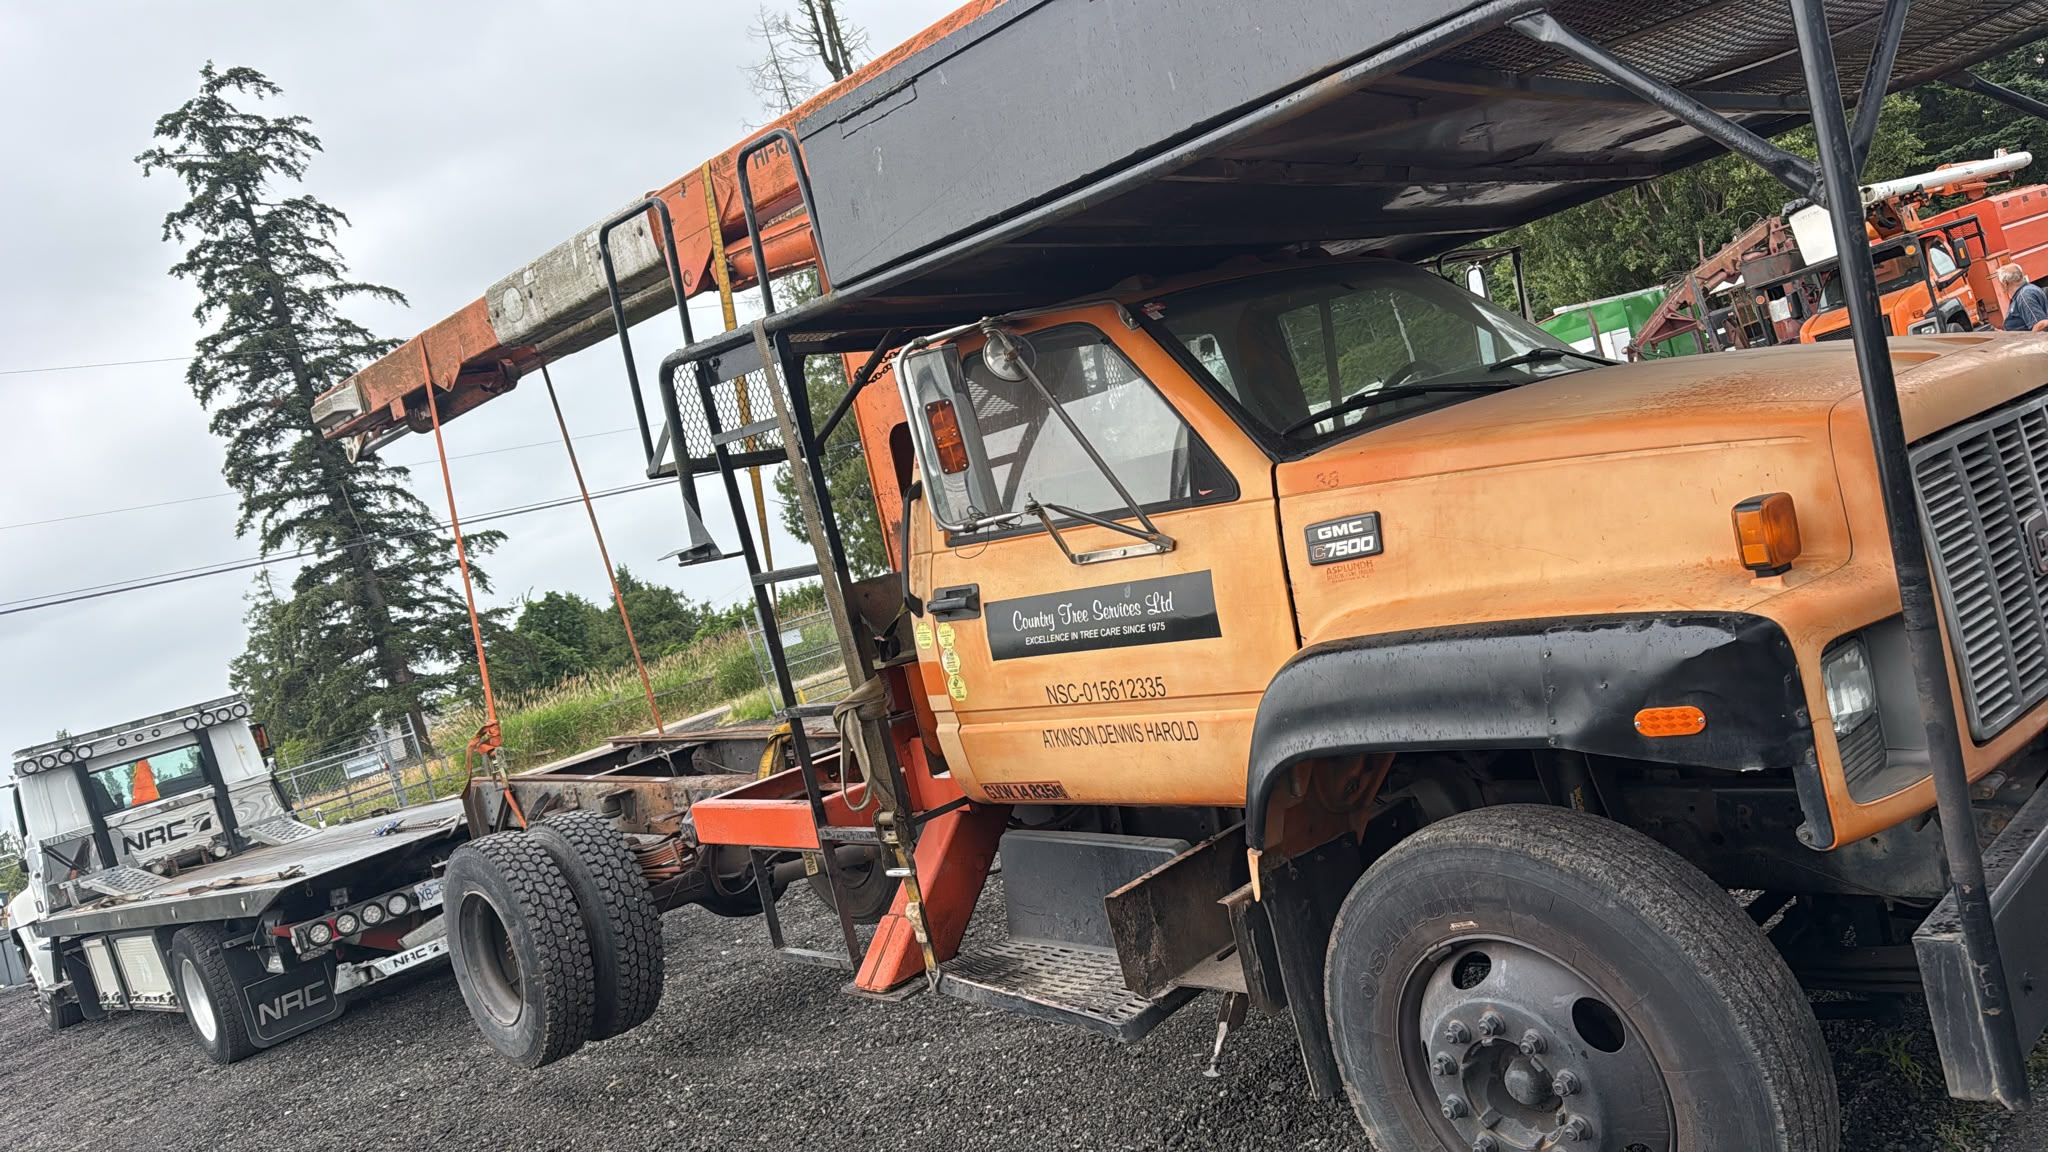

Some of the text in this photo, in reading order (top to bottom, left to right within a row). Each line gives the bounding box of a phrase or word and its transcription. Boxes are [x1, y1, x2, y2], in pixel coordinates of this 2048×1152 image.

[1317, 520, 1363, 540] GMC
[1313, 535, 1374, 560] C7500
[1326, 560, 1374, 575] ASPLUNDH
[1012, 591, 1175, 632] Country Tree Services Ltd
[1025, 621, 1166, 646] EXCELLENCE IN TREE CARE SINCE 1975
[1045, 676, 1167, 704] NSC-015612335
[1144, 720, 1199, 743] HAROLD
[122, 819, 188, 855] NRC
[392, 947, 428, 968] NRC
[258, 980, 327, 1026] NRC
